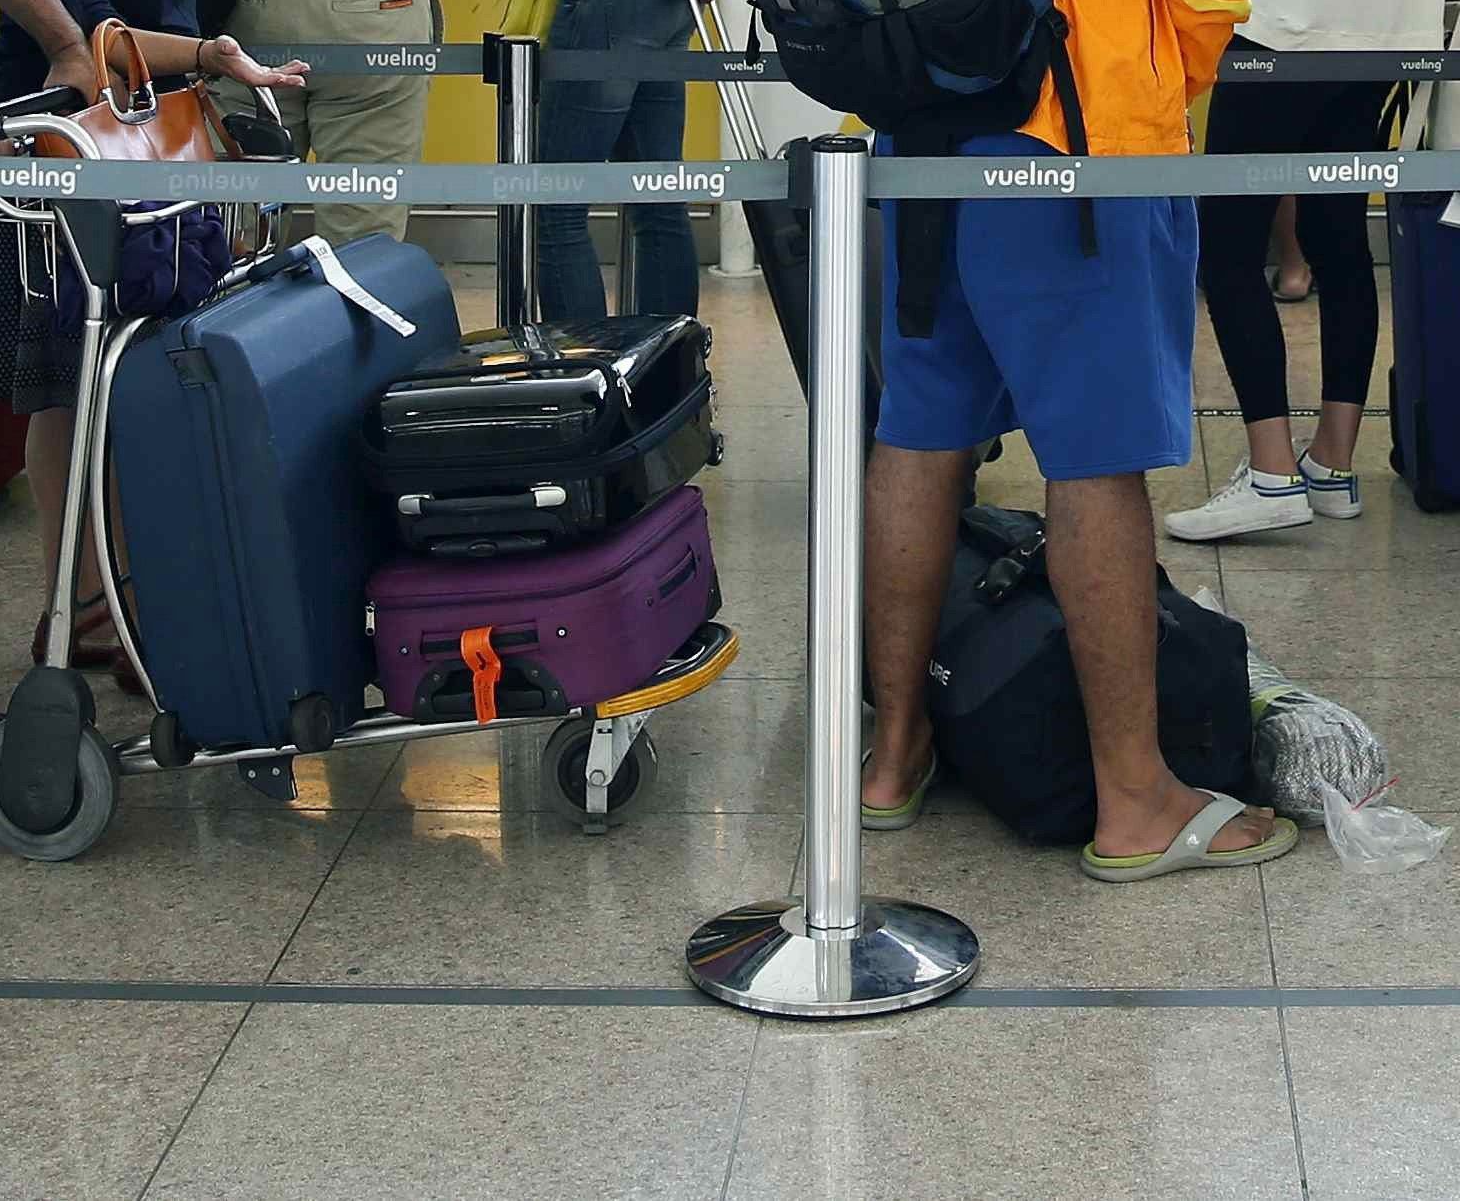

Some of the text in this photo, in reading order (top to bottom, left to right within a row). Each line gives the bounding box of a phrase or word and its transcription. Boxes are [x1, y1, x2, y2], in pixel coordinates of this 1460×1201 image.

[366, 47, 440, 71] vueling
[1232, 57, 1277, 73] vueling
[1400, 57, 1445, 73] vueling
[306, 167, 404, 200] vueling
[632, 165, 731, 196] vueling
[983, 160, 1082, 193] vueling
[1308, 156, 1405, 188] vueling
